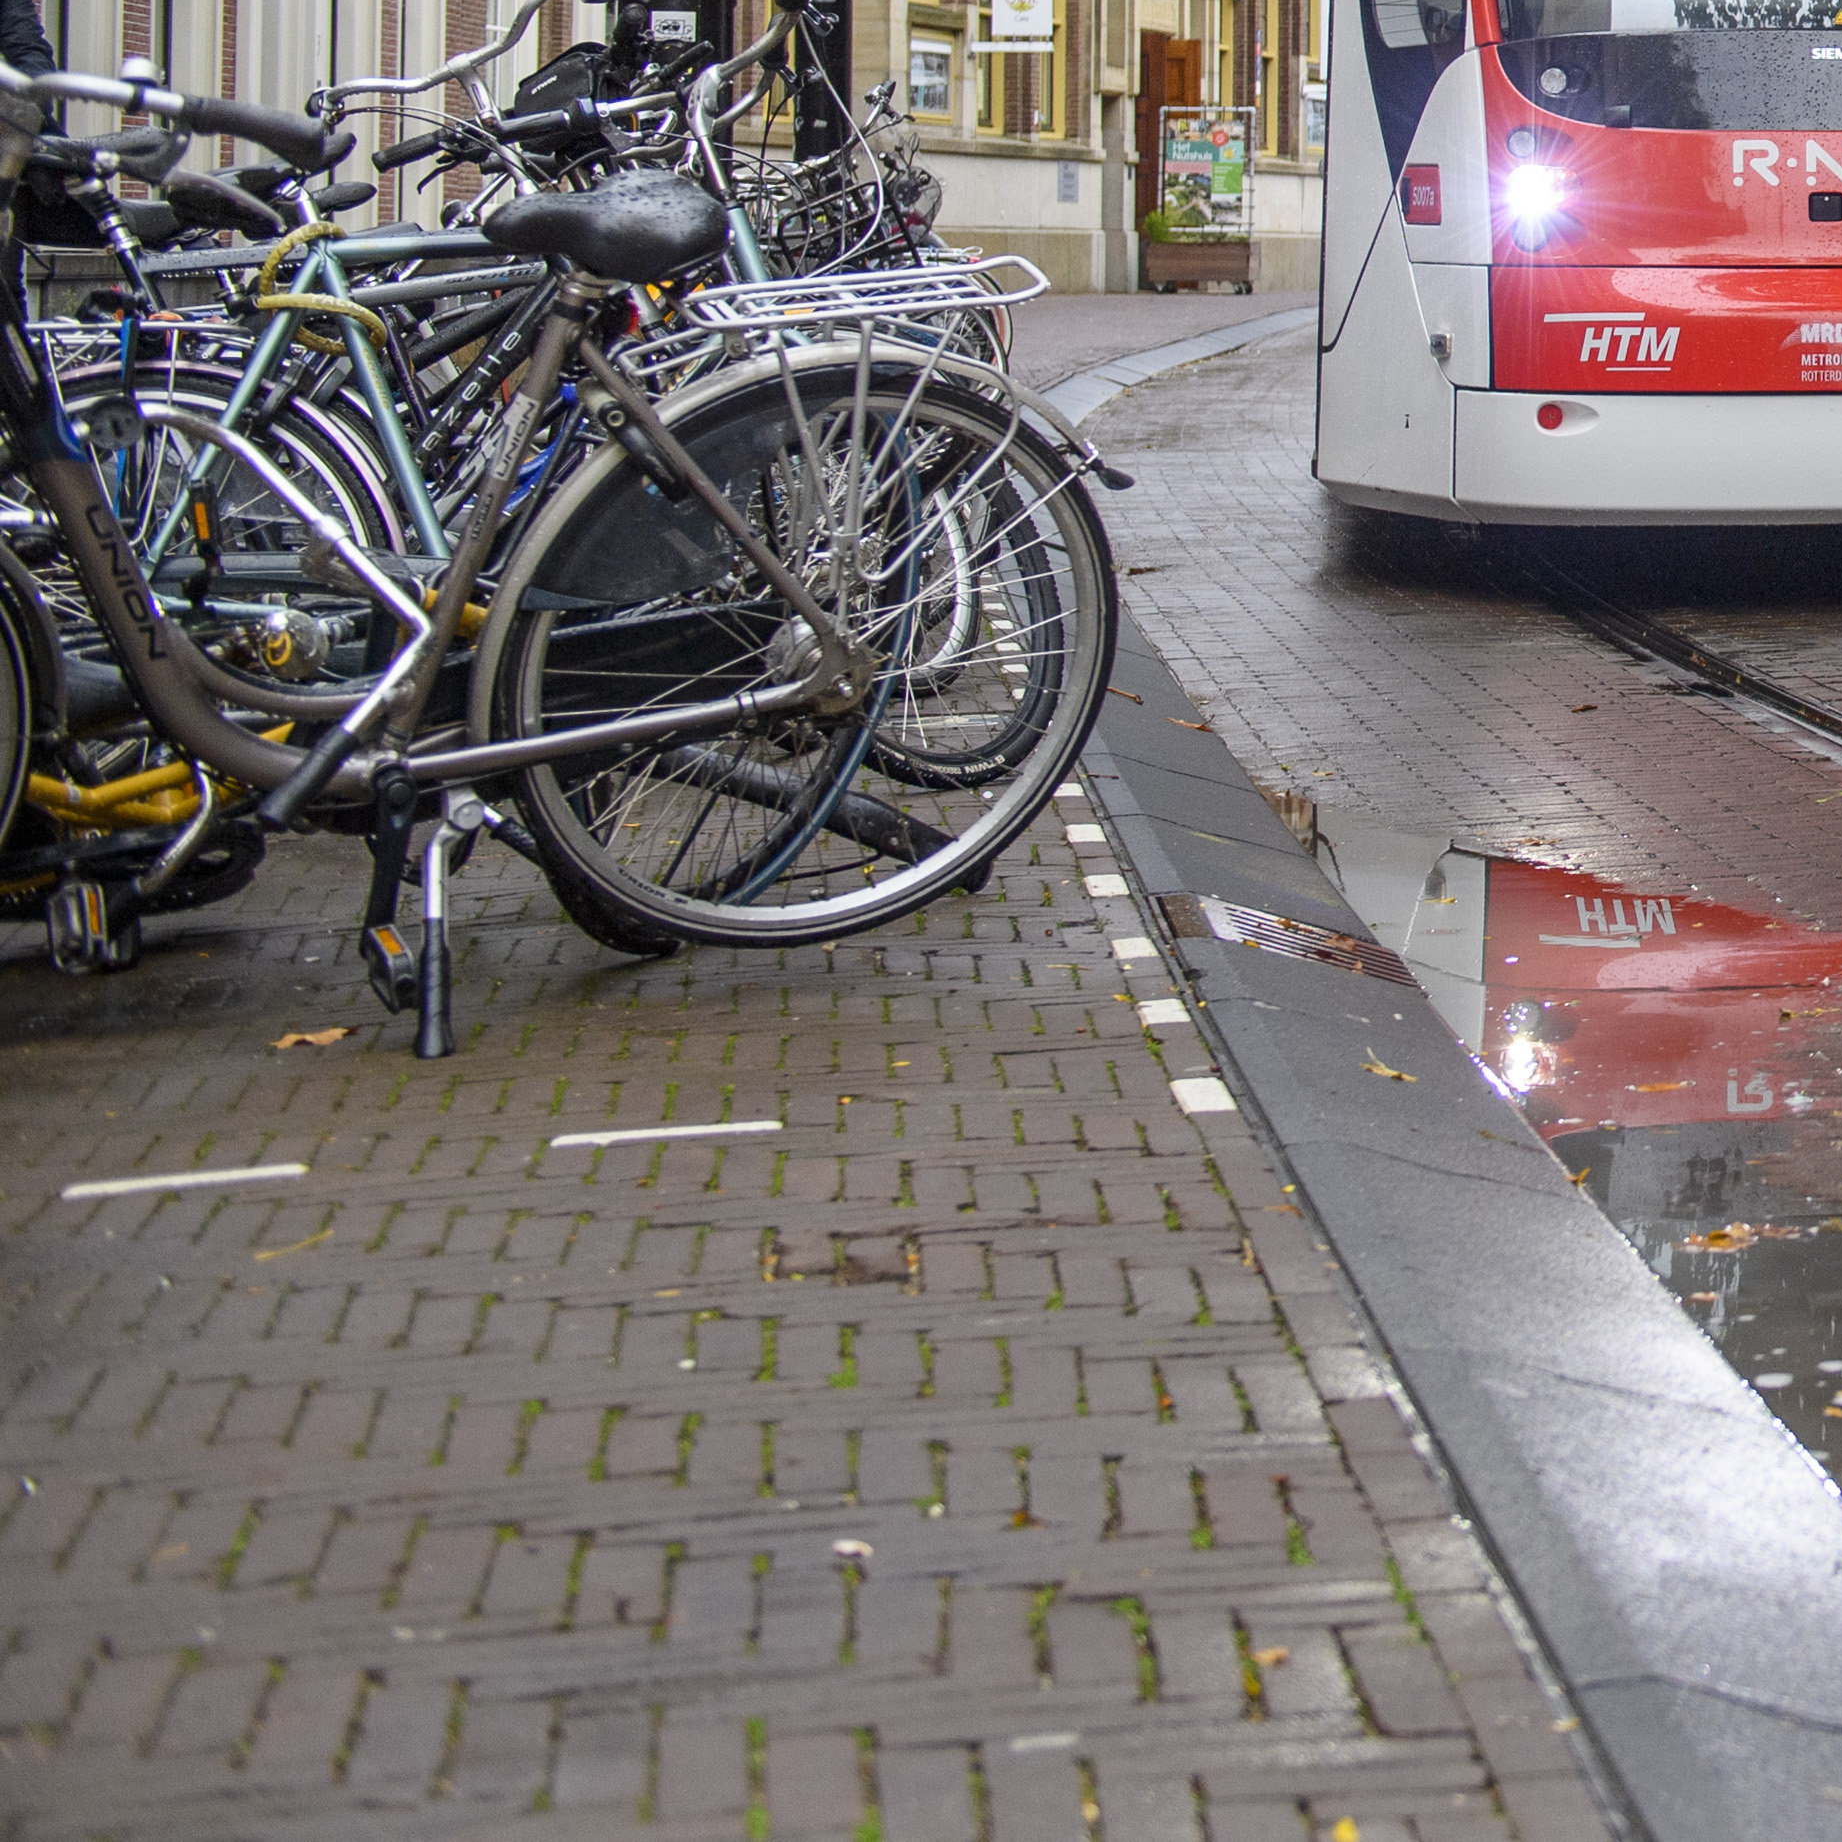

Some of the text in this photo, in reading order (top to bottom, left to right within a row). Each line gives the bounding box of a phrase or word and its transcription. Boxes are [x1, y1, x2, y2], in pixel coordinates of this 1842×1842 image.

[1580, 326, 1681, 363] HTM
[495, 401, 537, 479] UNION
[85, 504, 168, 661] UNION
